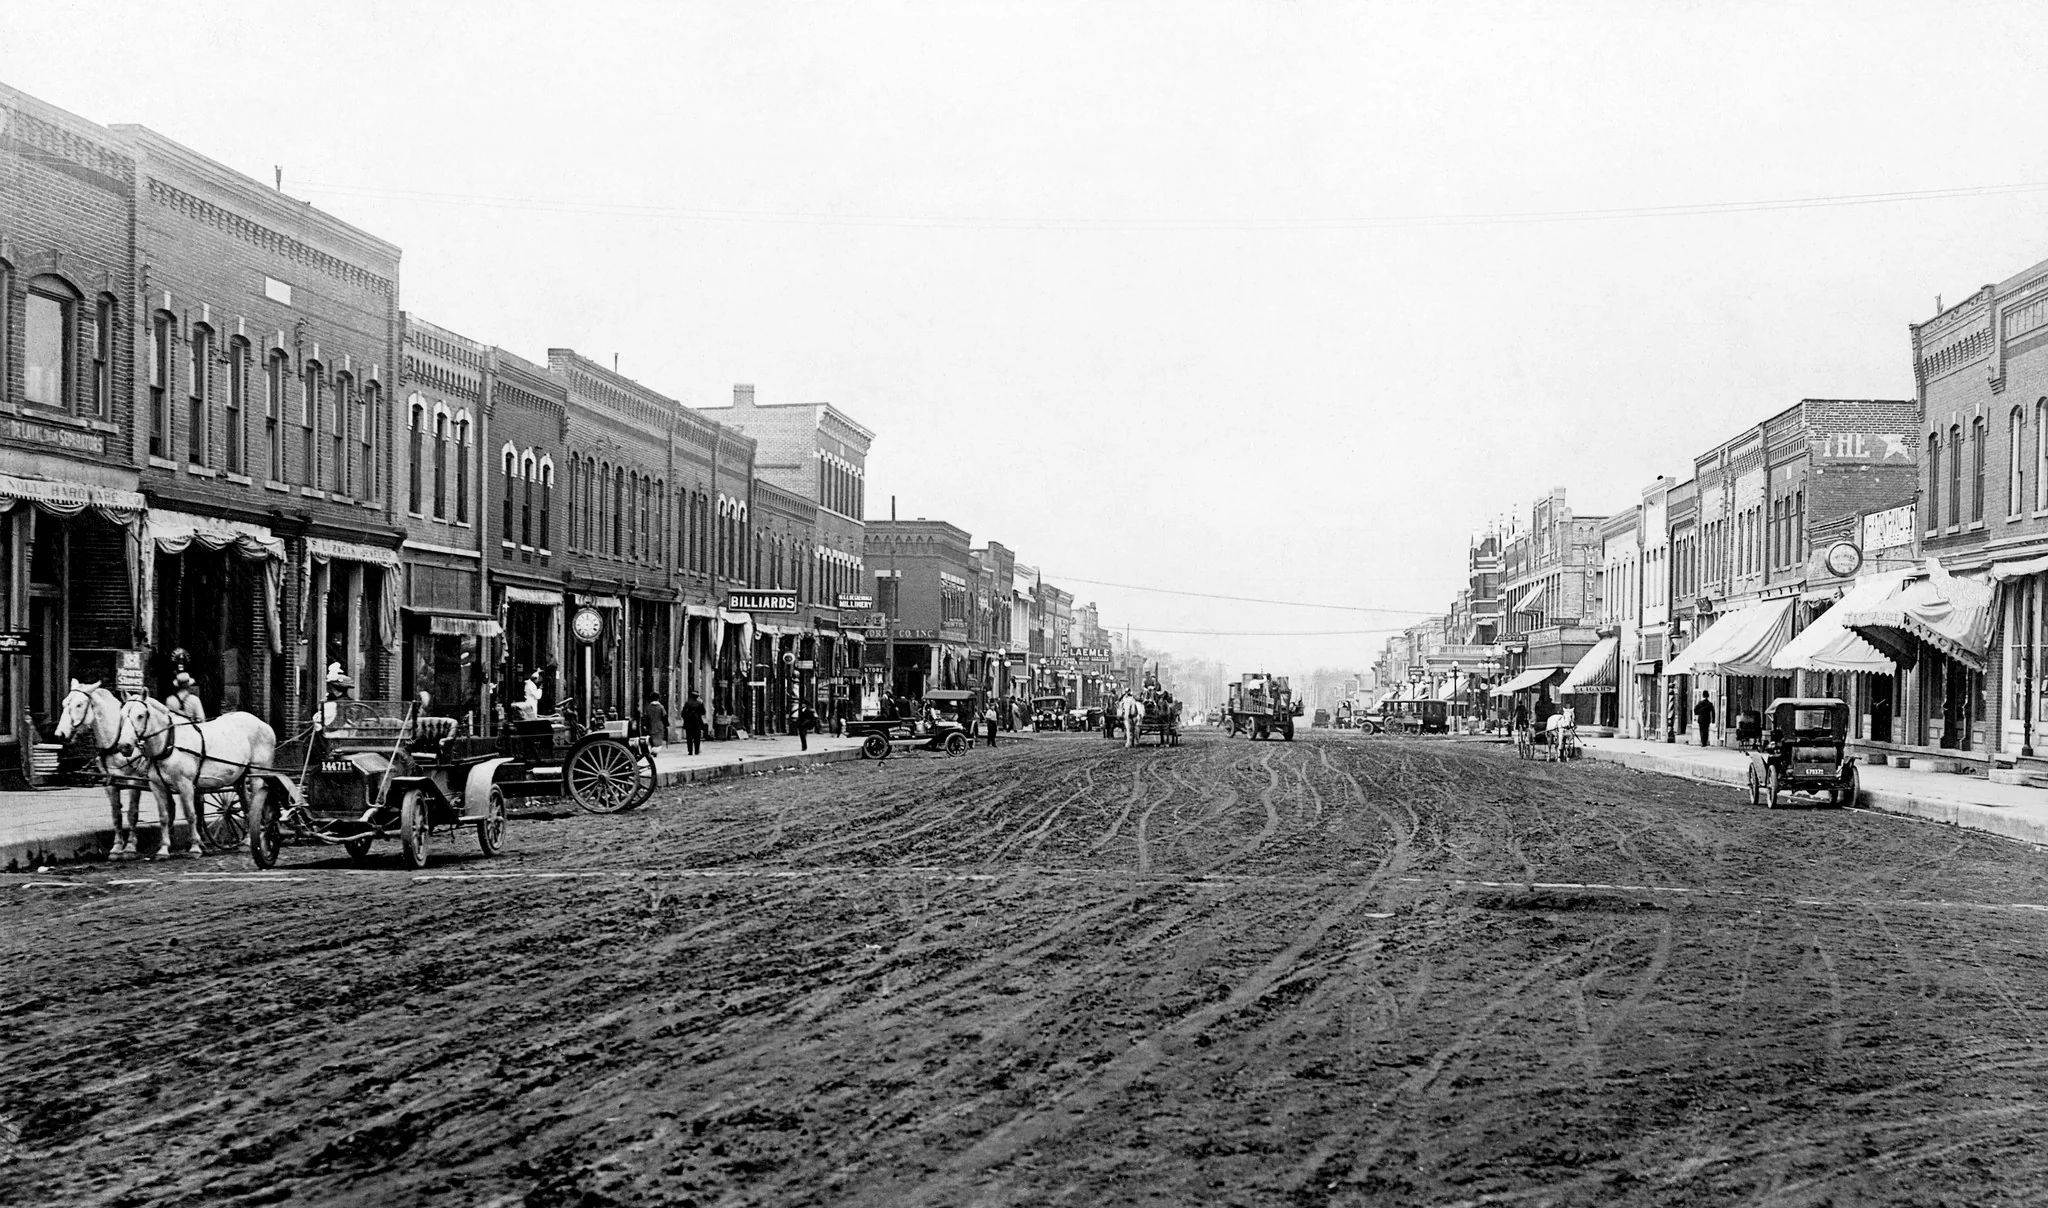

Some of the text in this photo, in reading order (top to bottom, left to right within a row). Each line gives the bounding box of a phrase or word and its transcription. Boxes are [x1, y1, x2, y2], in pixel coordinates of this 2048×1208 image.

[1821, 433, 1870, 457] THE
[51, 486, 118, 503] HARDARE
[1586, 556, 1595, 613] HOTEL
[731, 596, 795, 609] BILLIARDS
[1070, 648, 1110, 657] LAEMLE
